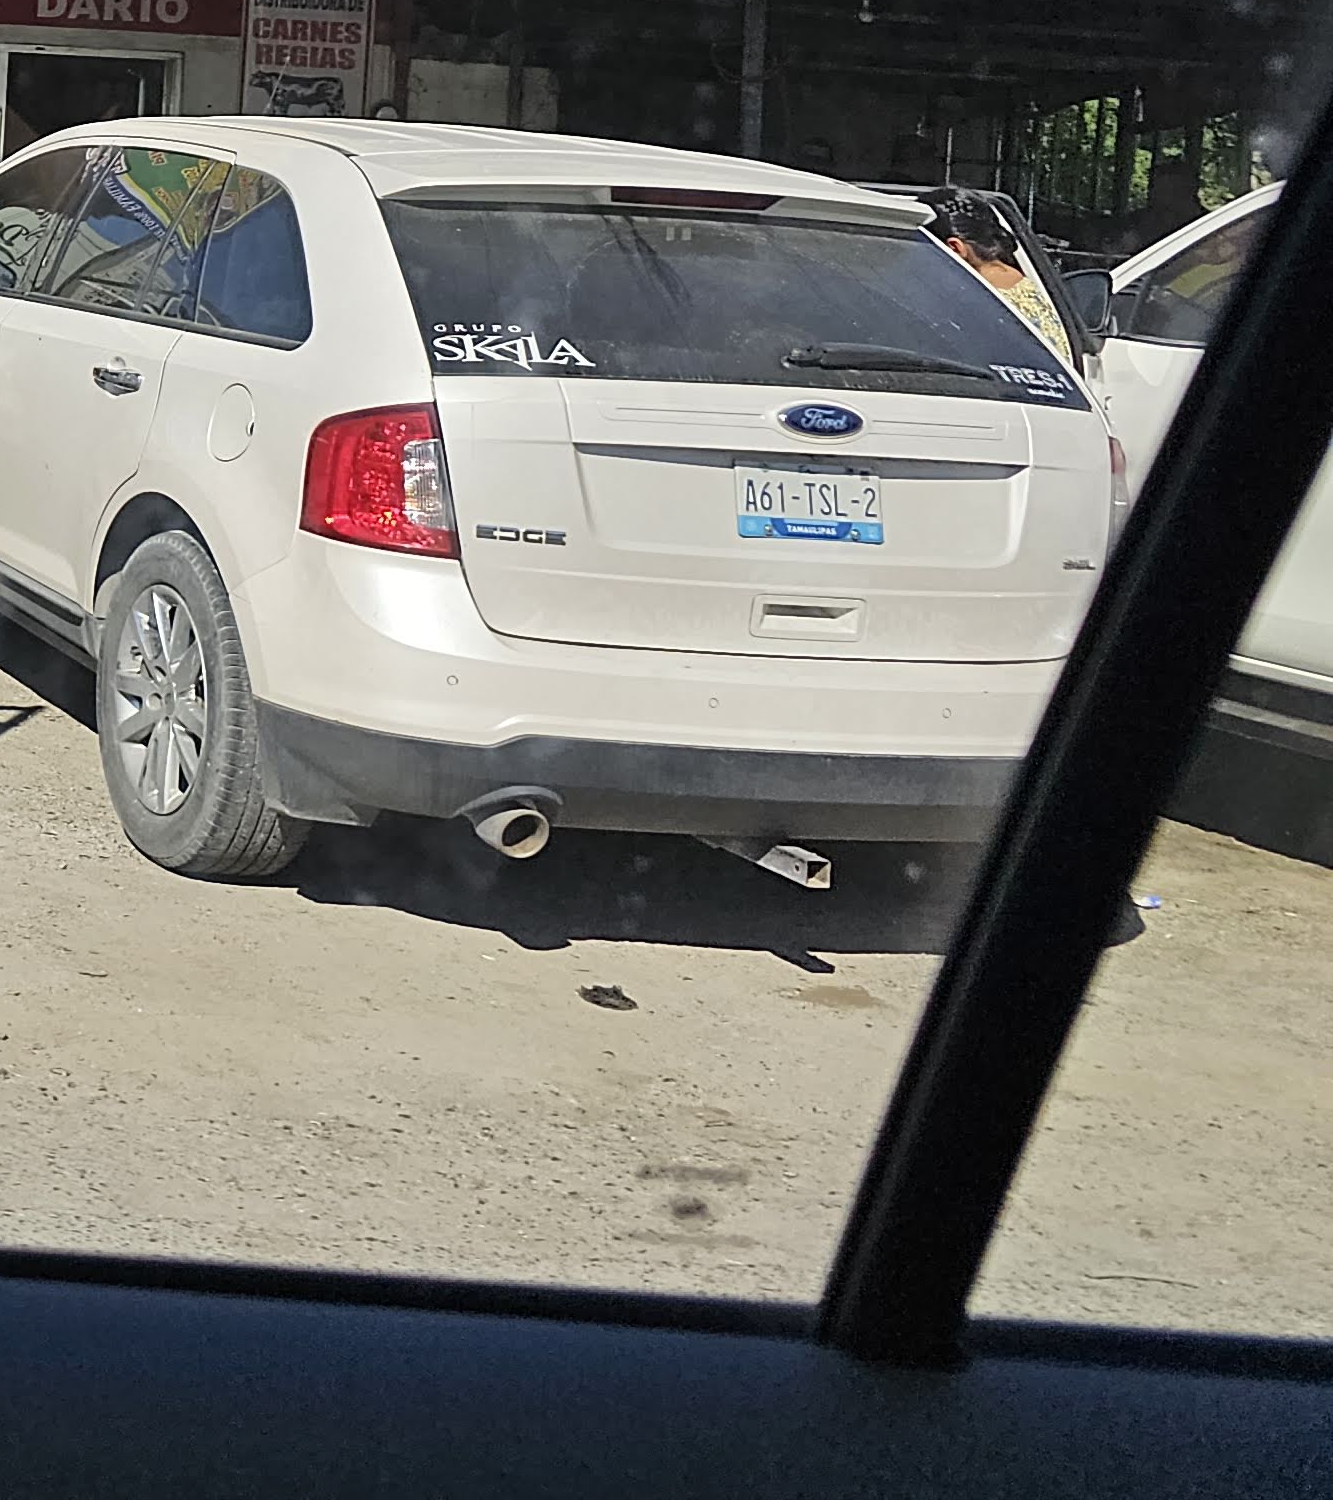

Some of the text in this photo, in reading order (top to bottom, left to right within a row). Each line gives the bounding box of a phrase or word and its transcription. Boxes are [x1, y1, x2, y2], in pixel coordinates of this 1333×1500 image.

[253, 18, 362, 44] CARNES
[255, 44, 356, 70] REGIAS
[800, 408, 847, 429] Ford
[746, 479, 877, 517] A61-TSL-2
[476, 524, 566, 546] EDGE
[787, 525, 837, 535] TAMAULIPAS
